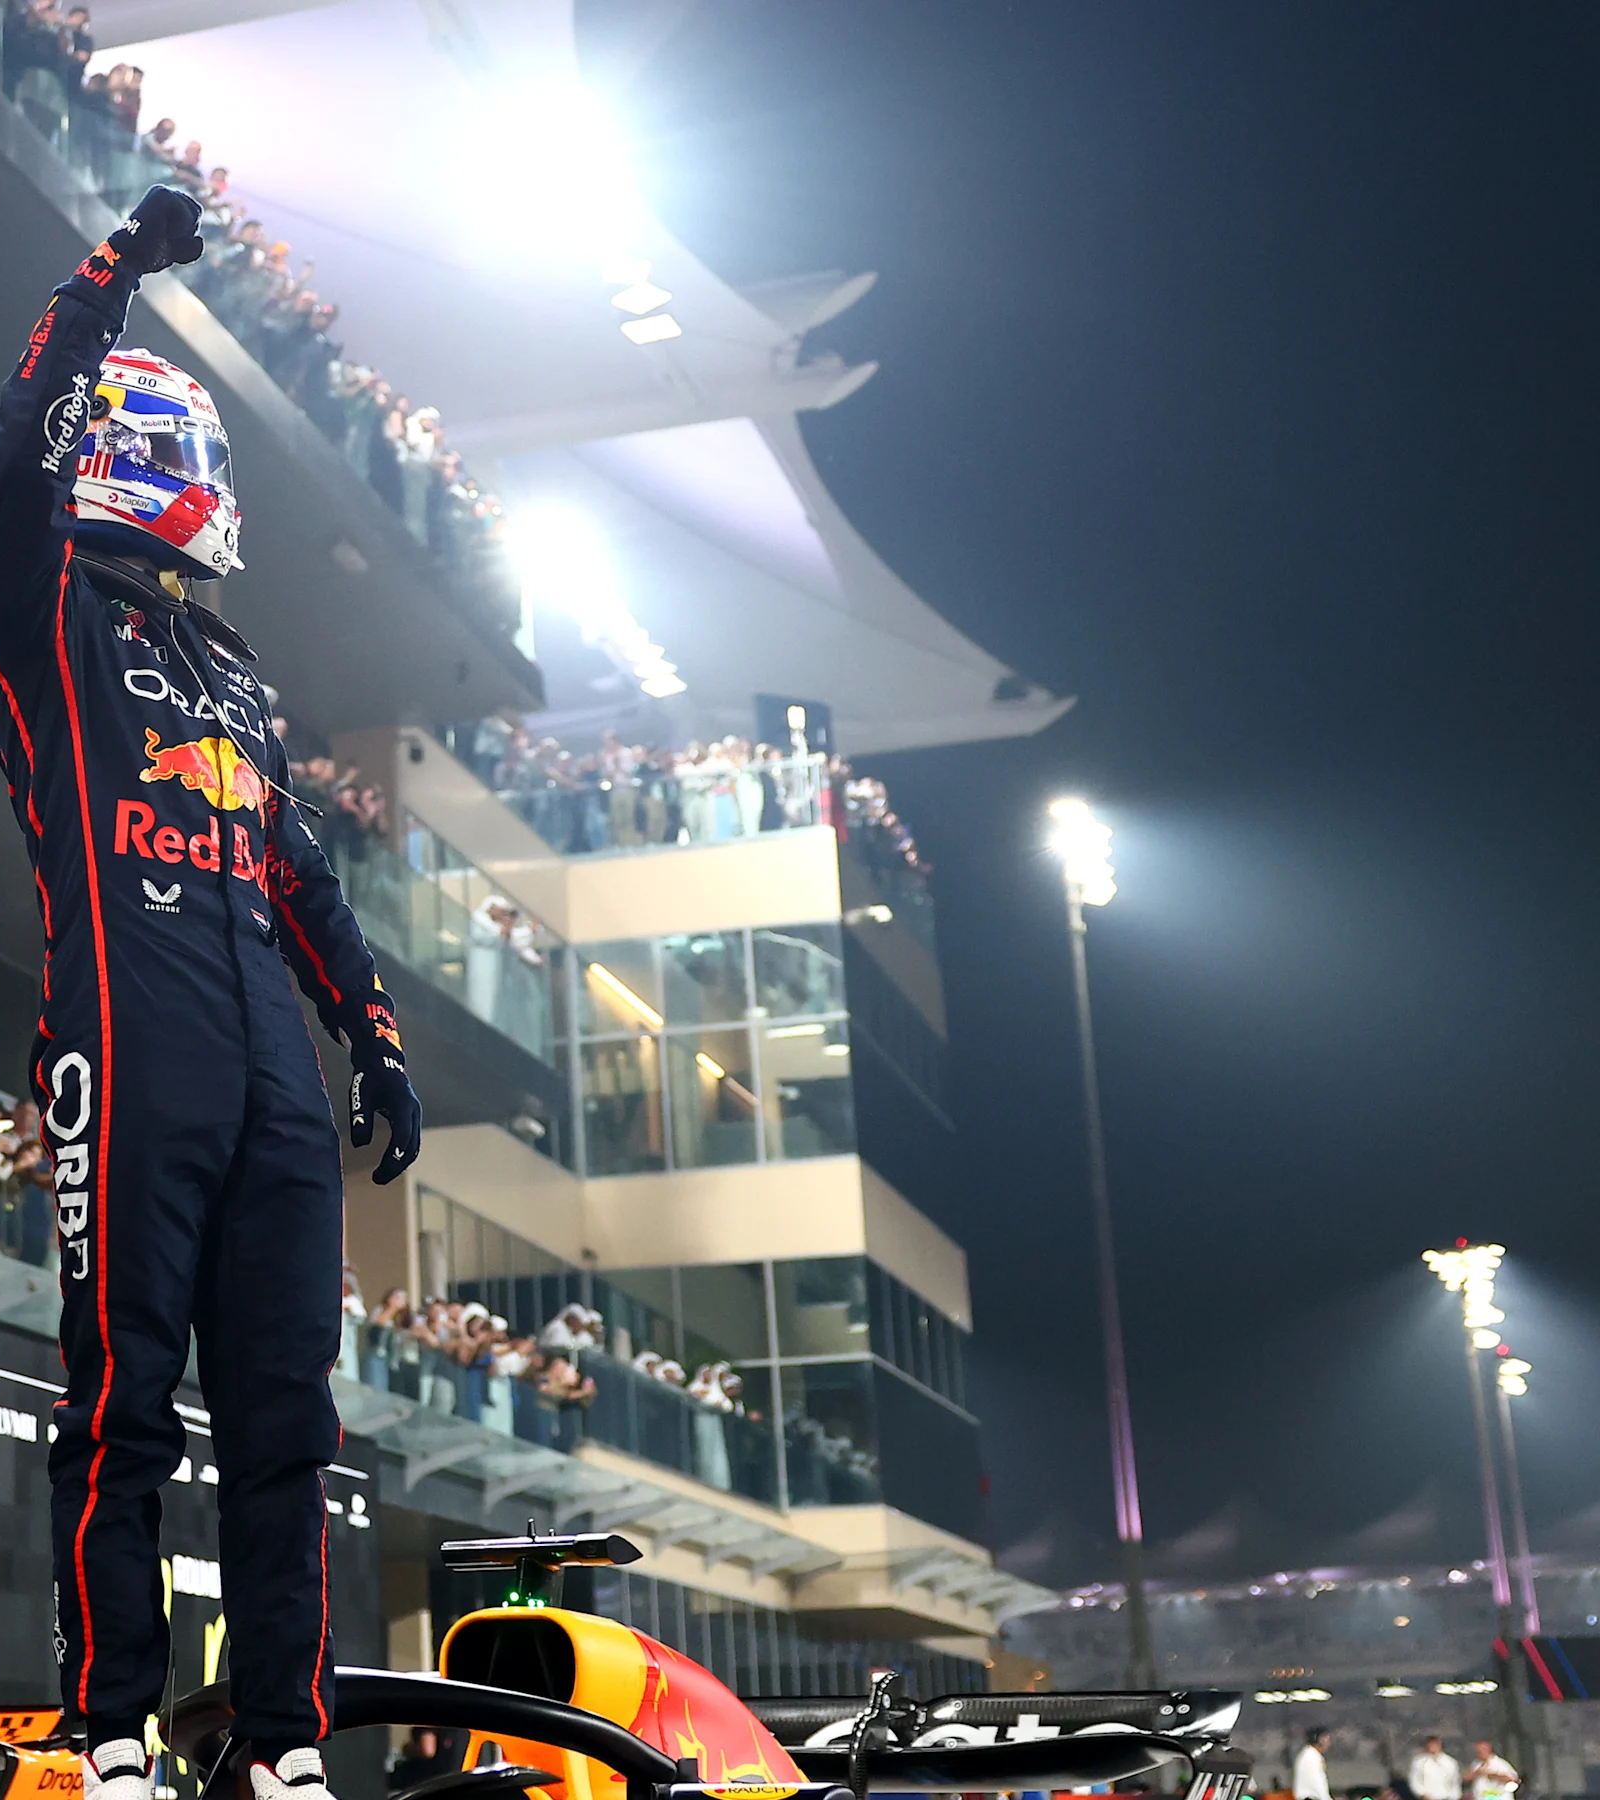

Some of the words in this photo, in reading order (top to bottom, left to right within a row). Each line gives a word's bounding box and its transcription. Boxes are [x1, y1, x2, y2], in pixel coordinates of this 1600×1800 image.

[20, 342, 43, 379] Red
[34, 311, 57, 345] Bull
[41, 420, 75, 474] Hard
[62, 372, 91, 424] Rock
[141, 420, 162, 428] Mobil
[120, 496, 150, 510] viaplay
[113, 798, 222, 874] Red
[144, 902, 181, 914] CASTORE
[728, 1786, 786, 1794] RAUCH
